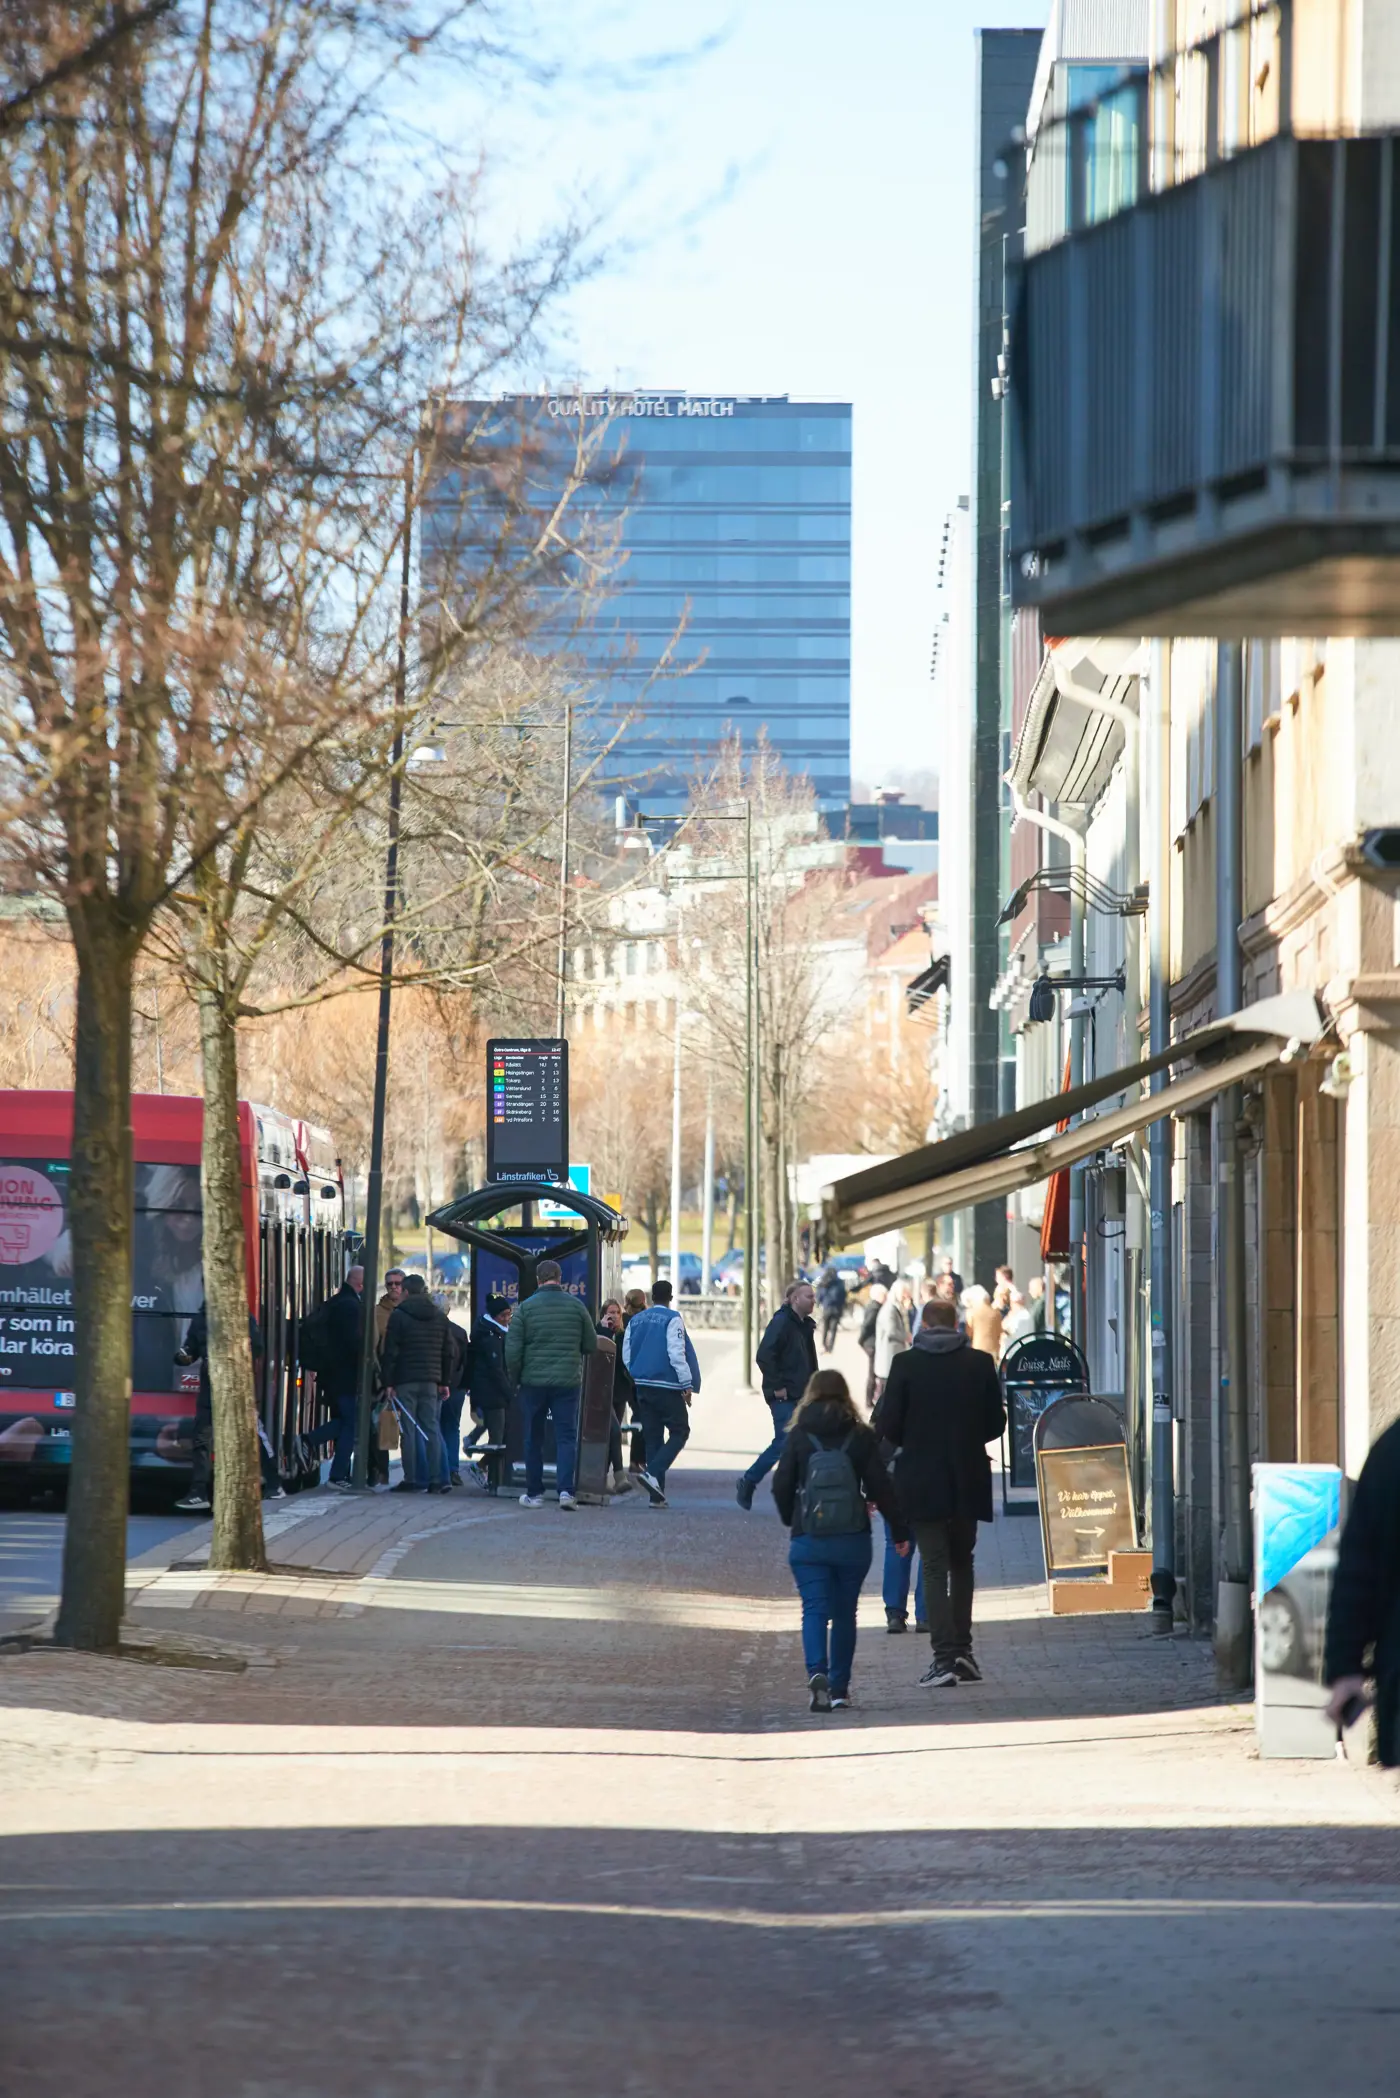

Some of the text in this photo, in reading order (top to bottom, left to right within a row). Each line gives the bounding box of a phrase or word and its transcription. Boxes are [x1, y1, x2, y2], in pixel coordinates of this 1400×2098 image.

[547, 400, 734, 417] QUALITY HOTEL MATCH
[496, 1172, 546, 1181] Länstrafiken
[0, 1286, 73, 1305] mhället
[9, 1318, 52, 1332] som
[1017, 1355, 1072, 1371] Louise Nails
[1058, 1490, 1070, 1502] Vi
[1072, 1491, 1090, 1501] har
[1060, 1502, 1118, 1518] Välkommen!
